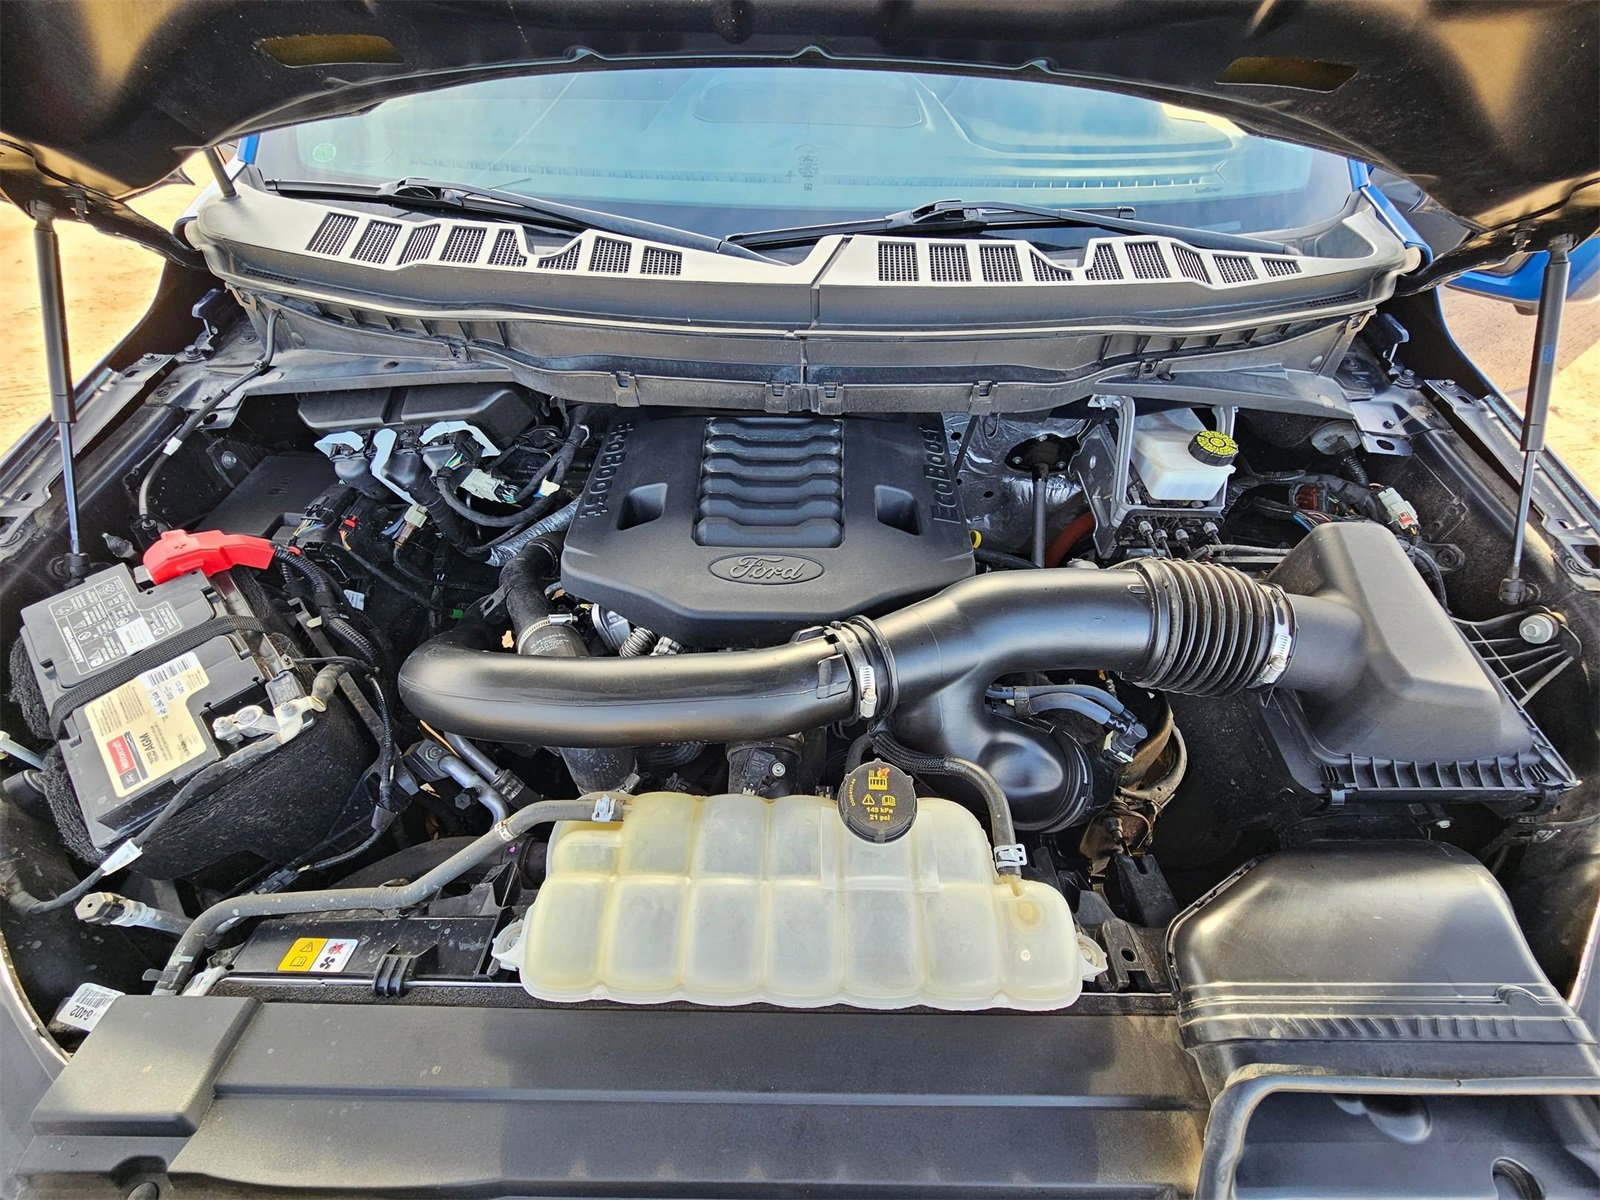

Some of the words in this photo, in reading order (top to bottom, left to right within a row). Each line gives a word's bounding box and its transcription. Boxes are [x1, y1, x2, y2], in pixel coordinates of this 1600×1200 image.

[581, 422, 633, 519] EcoBoost
[918, 426, 962, 525] EcoBoost
[729, 555, 806, 581] Ford
[111, 739, 130, 770] Motorcraft
[139, 731, 154, 752] AGM
[69, 1005, 93, 1020] 6402
